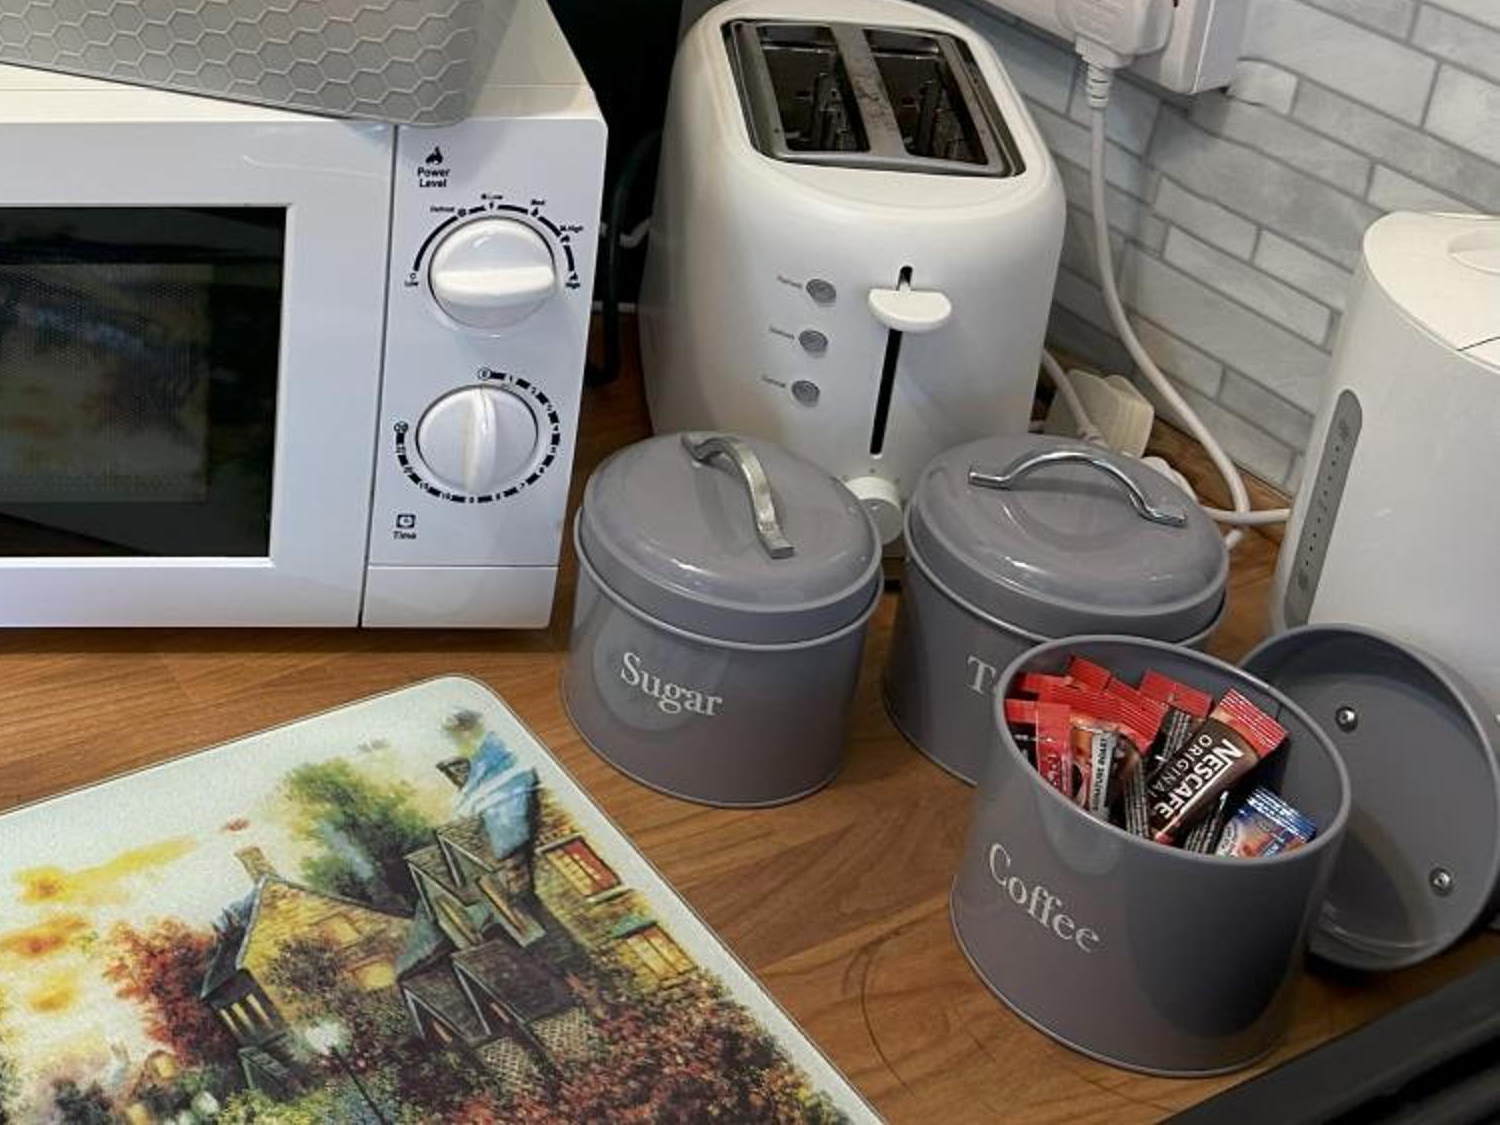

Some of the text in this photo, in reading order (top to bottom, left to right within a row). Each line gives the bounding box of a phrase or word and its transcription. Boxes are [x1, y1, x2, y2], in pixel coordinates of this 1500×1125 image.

[417, 167, 450, 178] Power
[419, 178, 447, 188] Level
[620, 651, 723, 716] Sugar
[989, 843, 1100, 953] Coffee
